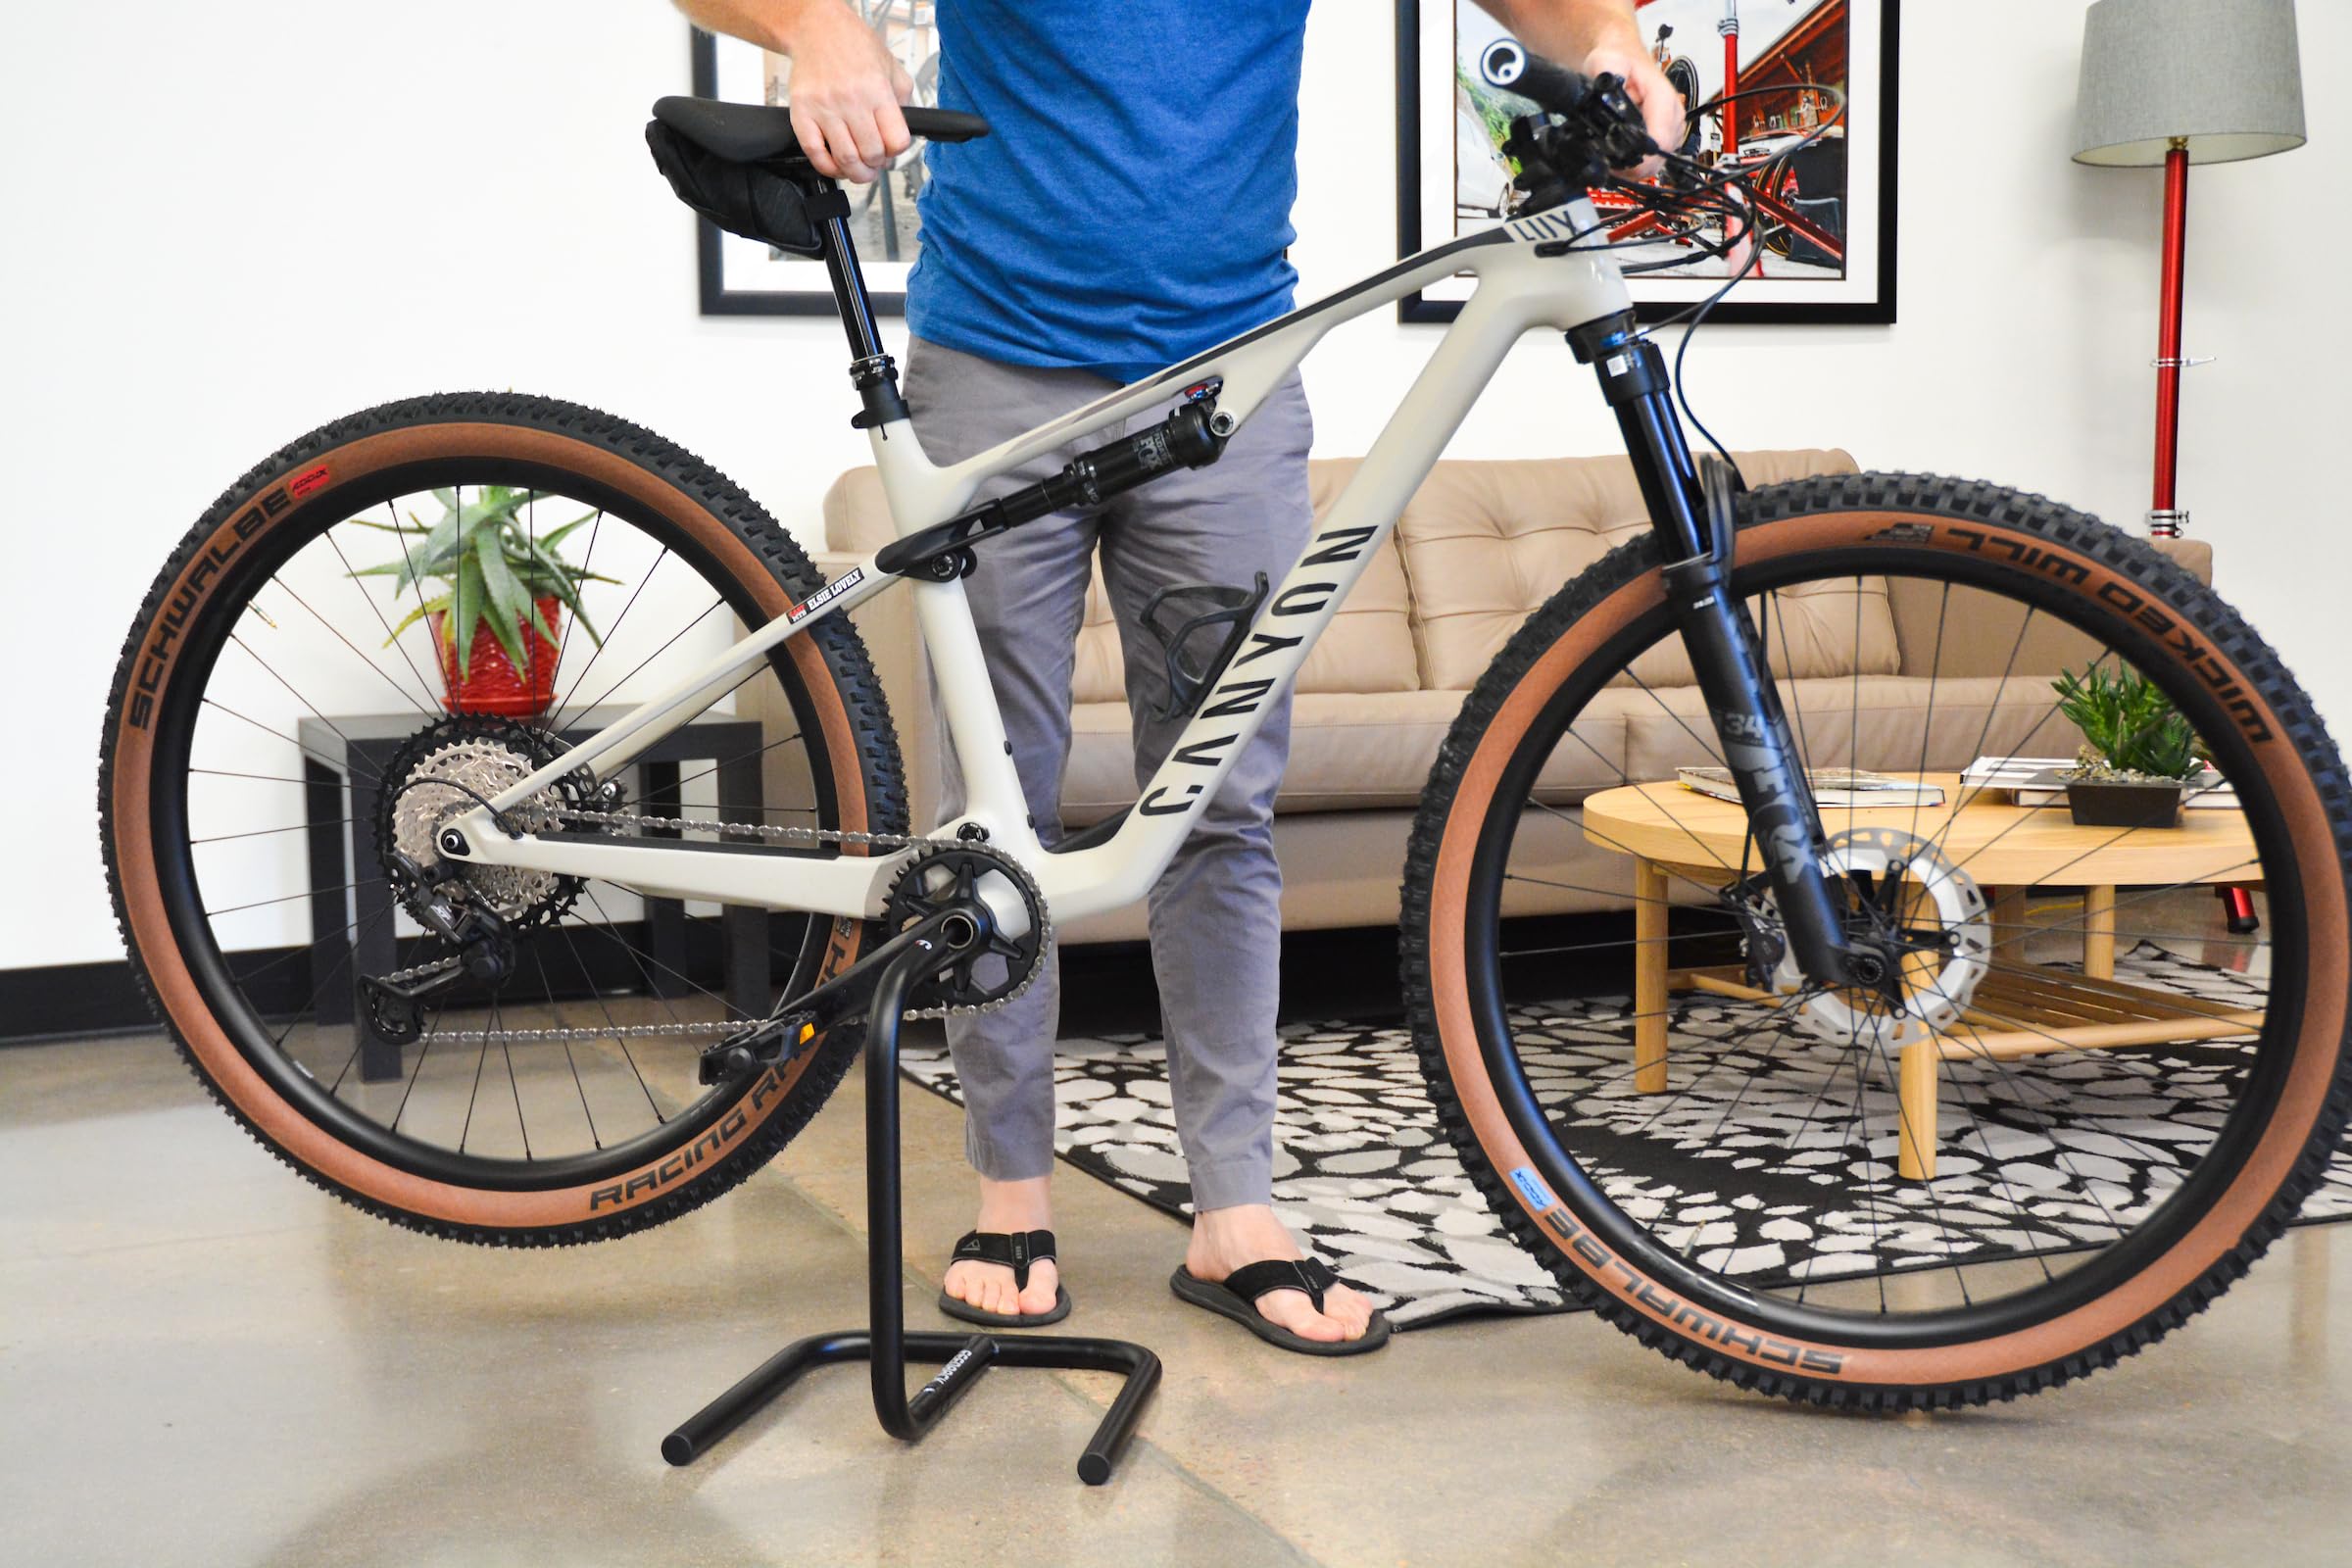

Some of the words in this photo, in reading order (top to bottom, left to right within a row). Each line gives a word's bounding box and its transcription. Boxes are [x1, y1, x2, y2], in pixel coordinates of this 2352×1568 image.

[128, 487, 292, 730] SCHWALBE
[807, 589, 833, 612] ELSIE
[829, 568, 861, 596] LOVELY
[1947, 528, 2091, 585] WILL
[1139, 524, 1379, 816] CANYON
[2097, 581, 2275, 743] WICKED
[1724, 712, 1765, 738] 34
[1751, 762, 1813, 884] FOX
[590, 1111, 748, 1210] RACING
[1544, 1207, 1844, 1374] SCHWALBE
